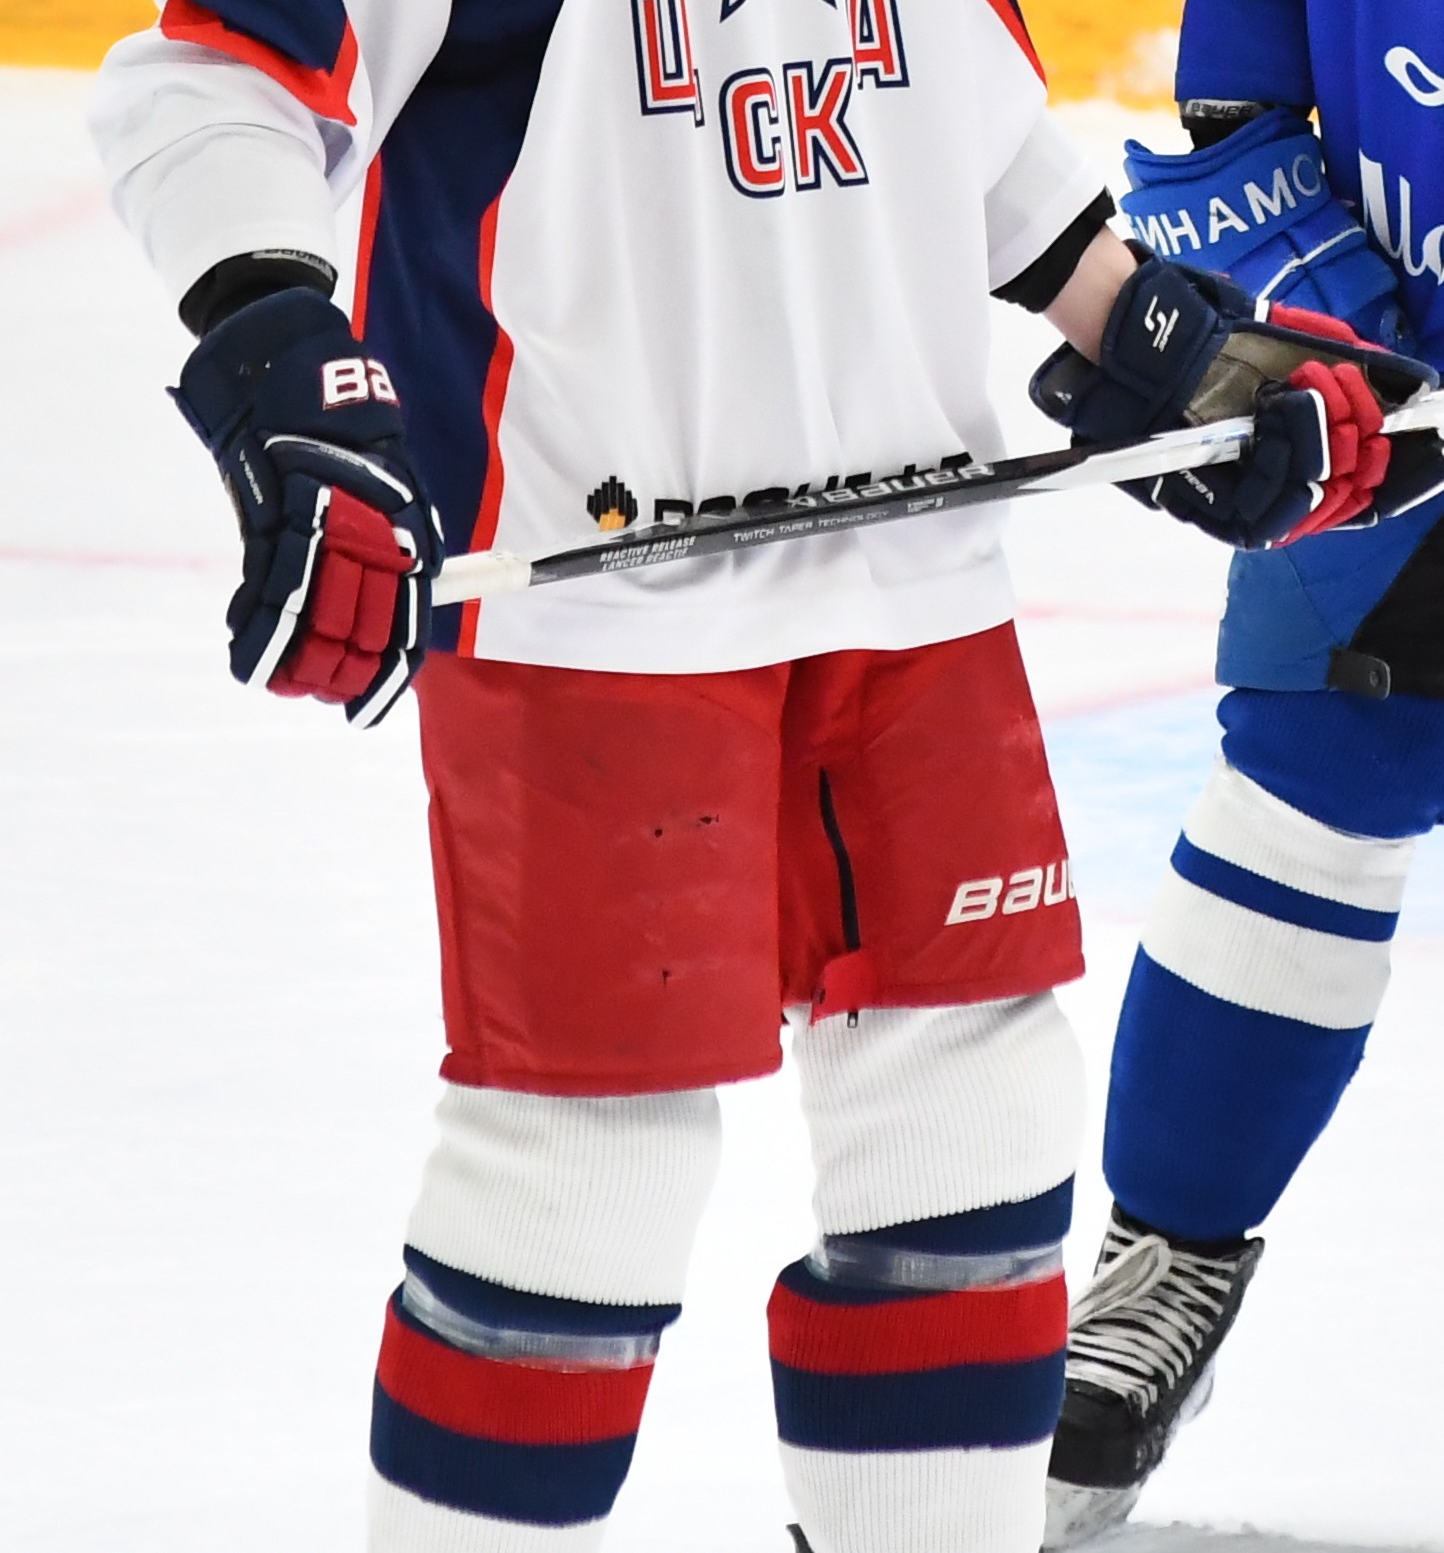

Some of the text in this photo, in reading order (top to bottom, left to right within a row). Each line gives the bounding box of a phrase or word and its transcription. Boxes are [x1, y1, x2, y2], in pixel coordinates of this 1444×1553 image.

[1133, 153, 1322, 256] ИНАМО
[822, 463, 996, 504] BAUER
[600, 535, 697, 563] REACTIVE RELEASE
